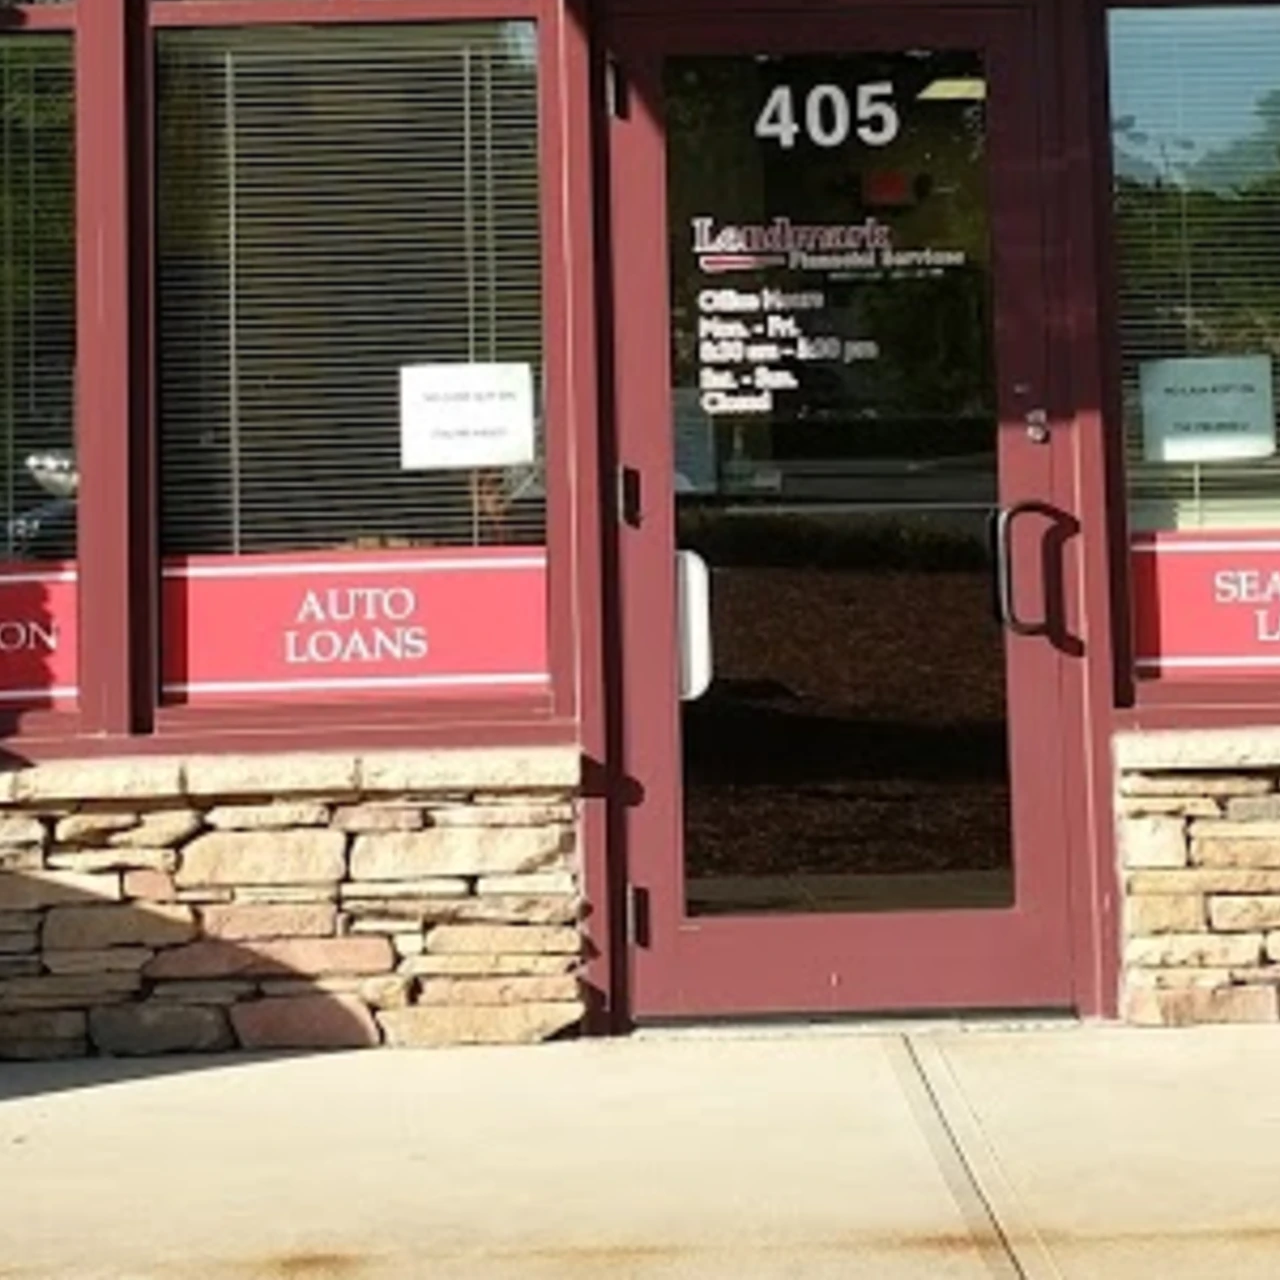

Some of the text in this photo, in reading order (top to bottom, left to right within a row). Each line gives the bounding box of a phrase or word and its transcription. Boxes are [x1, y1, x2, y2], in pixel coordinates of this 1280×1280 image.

[754, 81, 901, 148] 405
[297, 586, 416, 623] AUTO
[284, 626, 429, 663] LOANS
